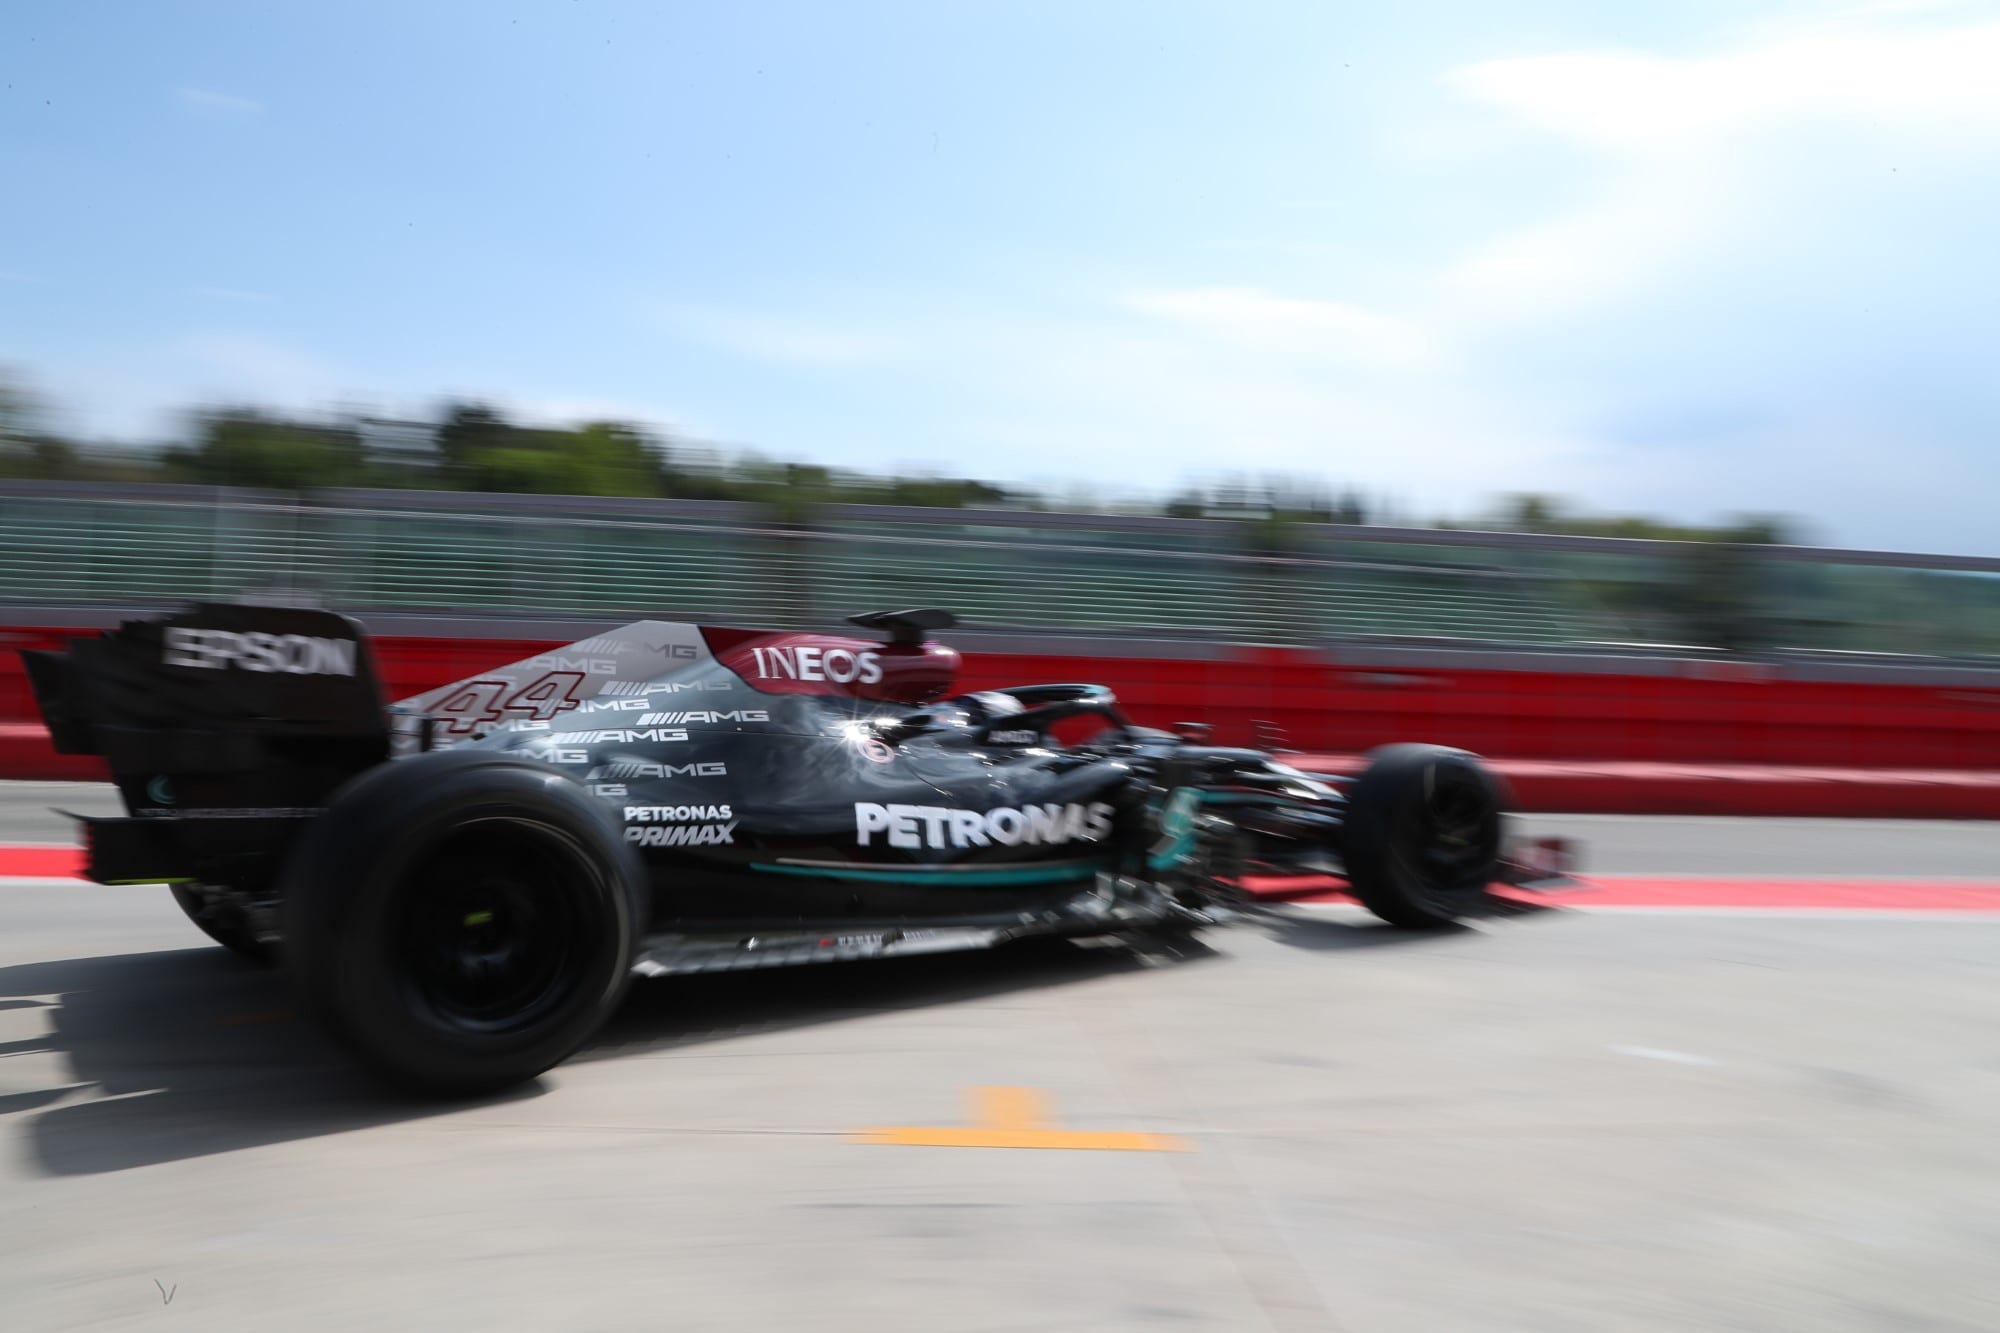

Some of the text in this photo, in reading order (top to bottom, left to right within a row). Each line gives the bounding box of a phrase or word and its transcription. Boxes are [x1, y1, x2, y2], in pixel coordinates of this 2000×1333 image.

[162, 626, 357, 677] EPSON
[521, 656, 617, 676] AMG
[751, 645, 884, 685] INEOS
[642, 679, 733, 696] AMG
[424, 670, 586, 734] 44
[678, 710, 770, 724] AMG
[592, 728, 689, 743] AMG
[631, 762, 727, 779] AMG
[623, 804, 733, 822] PETRONAS
[622, 820, 738, 847] PRIMAX
[854, 801, 1115, 850] PETRONAS
